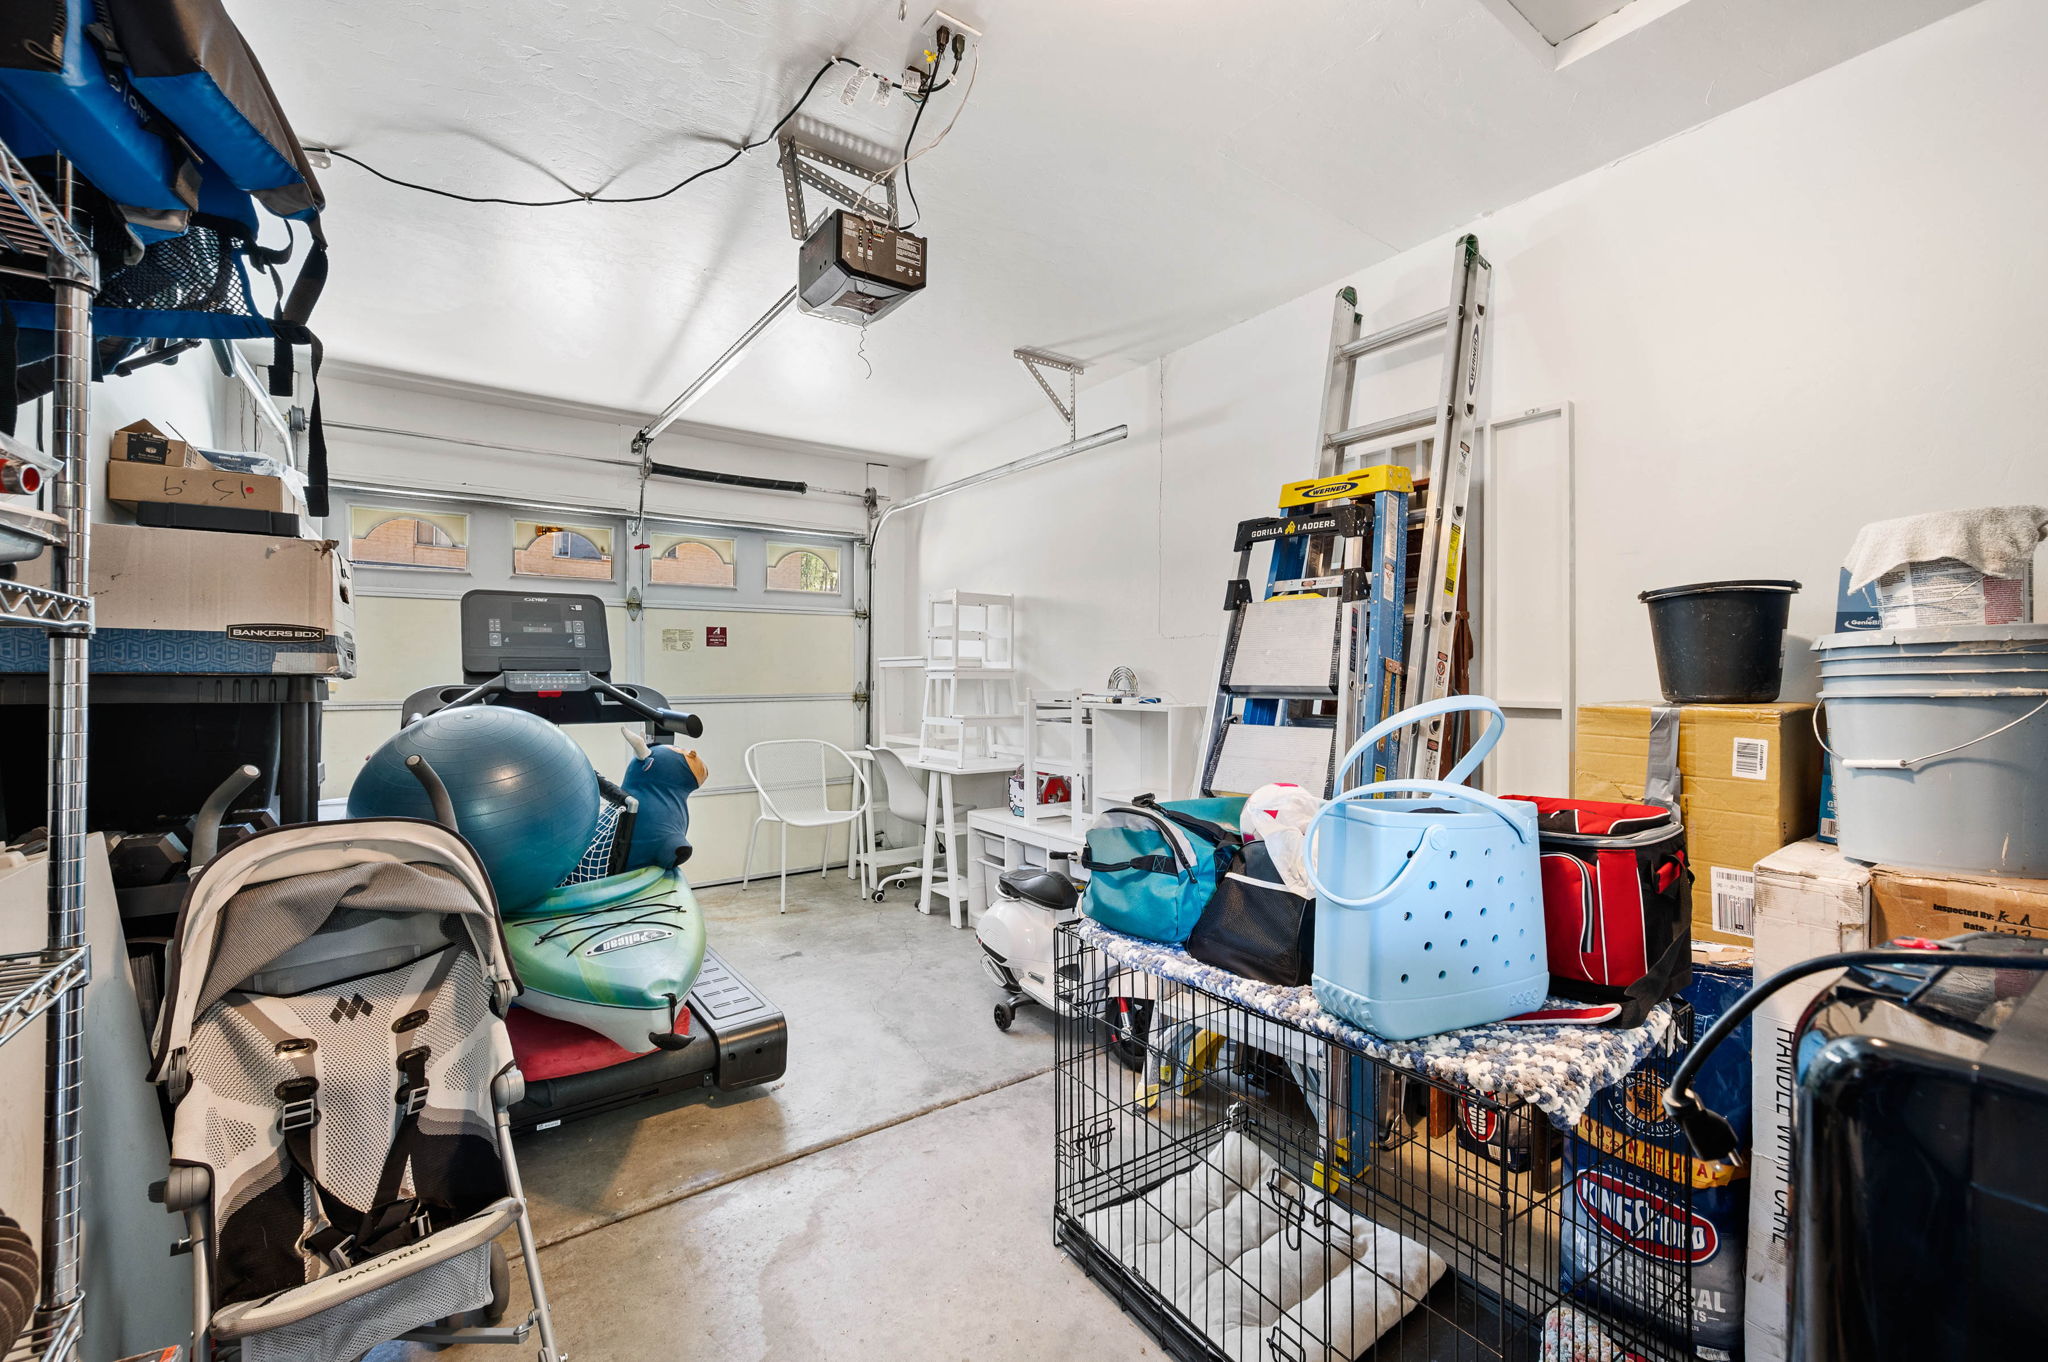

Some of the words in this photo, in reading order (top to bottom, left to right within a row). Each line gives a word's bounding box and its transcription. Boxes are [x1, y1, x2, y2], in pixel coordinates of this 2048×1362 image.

[1470, 337, 1478, 382] WERNER
[1312, 484, 1348, 496] WERNER
[1251, 527, 1283, 538] GORILLA
[1297, 519, 1336, 531] LADDERS
[232, 629, 293, 637] BANKERS
[1933, 903, 1979, 918] Inspected
[1979, 911, 1995, 921] By:
[1963, 922, 1987, 932] Date:
[602, 931, 649, 951] Pelican
[338, 1243, 431, 1283] MACLAREN
